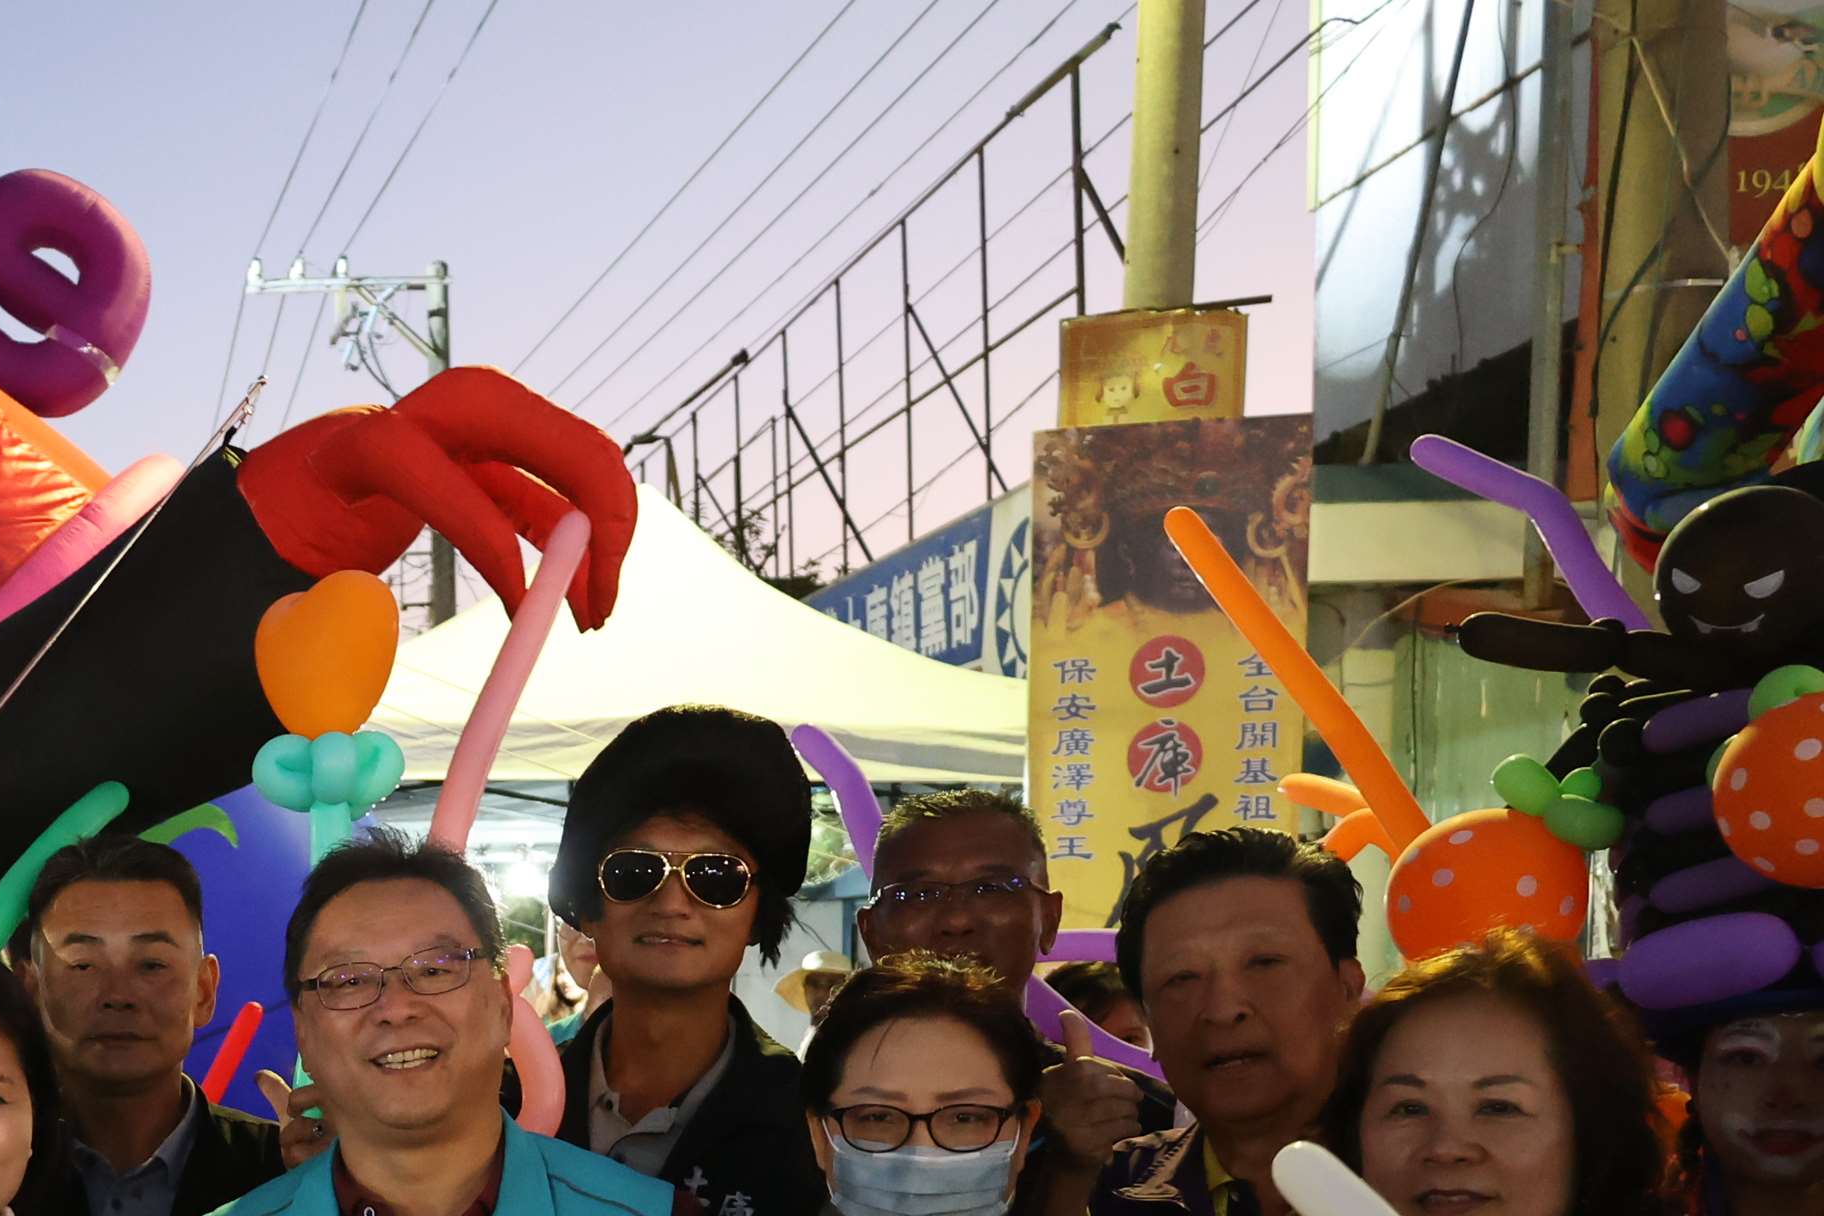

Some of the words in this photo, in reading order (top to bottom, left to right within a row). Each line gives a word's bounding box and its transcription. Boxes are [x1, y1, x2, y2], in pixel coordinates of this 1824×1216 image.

[825, 539, 980, 655] 庫鎮黨部
[1050, 658, 1097, 861] 保安廣澤尊王
[1135, 647, 1197, 797] 土庫
[1233, 653, 1279, 821] 全台開基祖
